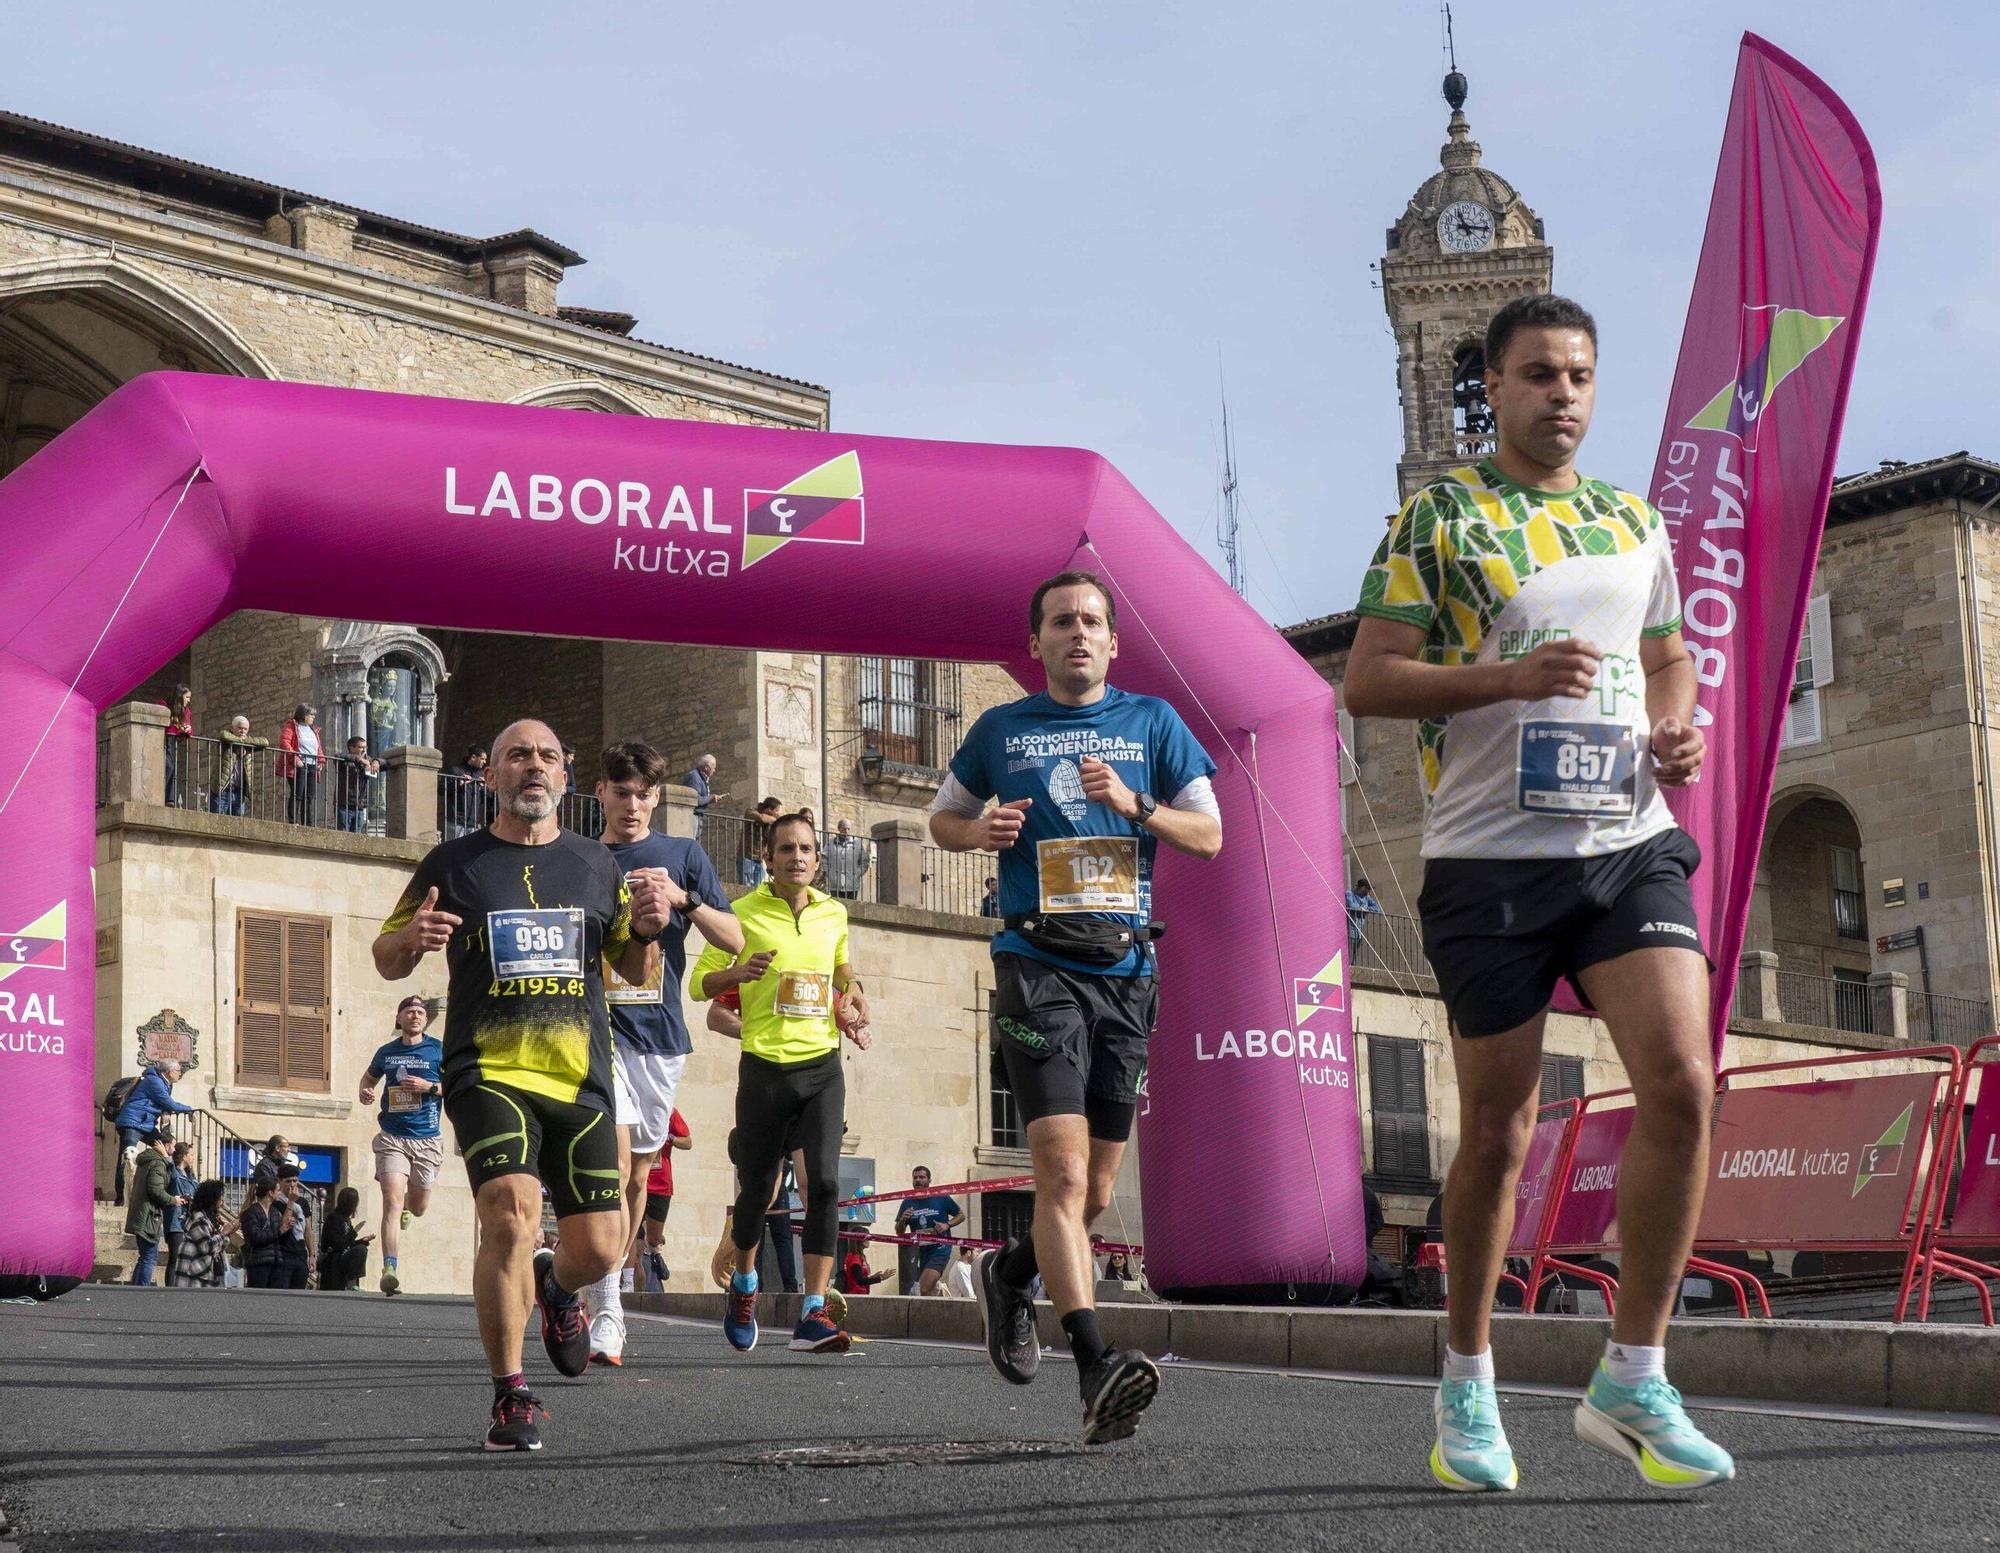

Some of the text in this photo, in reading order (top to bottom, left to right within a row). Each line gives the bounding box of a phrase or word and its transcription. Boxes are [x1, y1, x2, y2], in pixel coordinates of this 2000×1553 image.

[445, 467, 732, 534] LABORAL
[613, 537, 730, 577] kutxa
[1006, 730, 1098, 747] LA CONQUISTA
[1024, 736, 1127, 758] ALMENDRA
[1127, 742, 1144, 751] REN
[1556, 743, 1617, 782] 857
[1068, 855, 1114, 884] 162
[515, 926, 564, 952] 936
[488, 977, 585, 997] 42195.es
[793, 983, 819, 1001] 503
[1195, 1030, 1347, 1062] LABORAL
[1301, 1064, 1348, 1088] kutxa
[483, 1154, 509, 1168] 42
[1718, 1148, 1849, 1178] LABORAL kutxa
[1572, 1164, 1616, 1192] LABORAL
